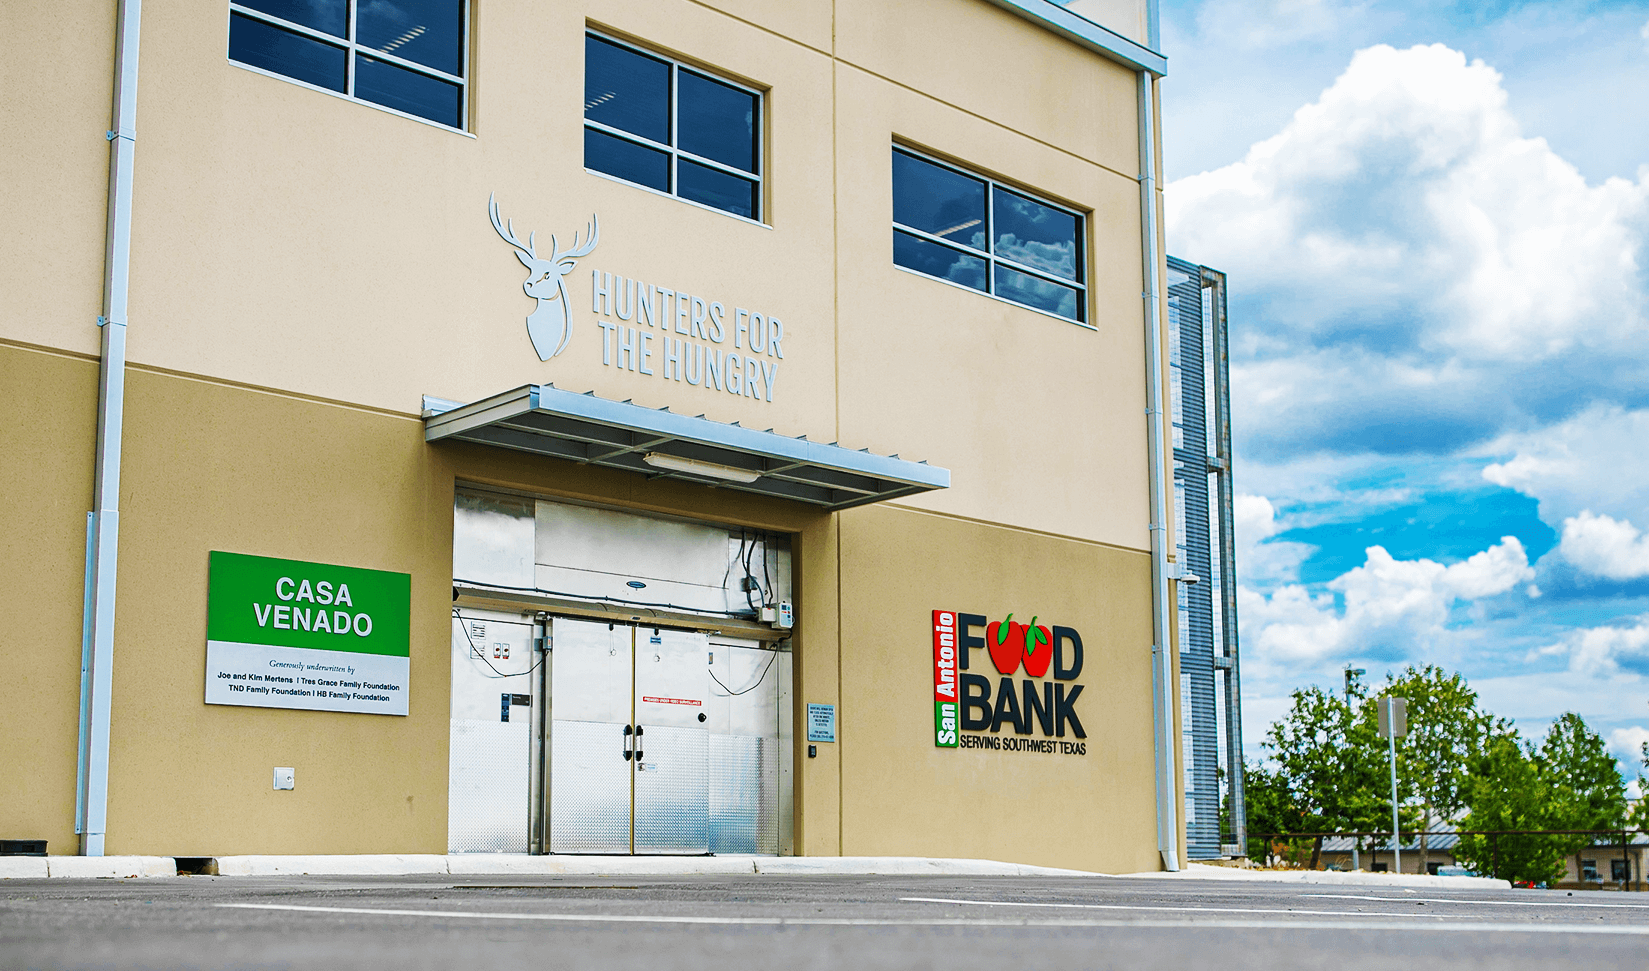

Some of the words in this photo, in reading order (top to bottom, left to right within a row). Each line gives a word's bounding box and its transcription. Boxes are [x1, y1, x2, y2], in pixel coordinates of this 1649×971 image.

[592, 269, 725, 343] HUNTERS
[735, 307, 784, 359] FOR
[598, 320, 654, 376] THE
[664, 336, 778, 402] HUNGRY
[275, 576, 353, 607] CASA
[253, 602, 373, 637] VENADO
[269, 660, 305, 671] Generously
[306, 663, 346, 673] underwritten
[347, 666, 356, 675] by
[936, 612, 955, 698] Antonio
[217, 672, 231, 680] Joe
[248, 674, 263, 682] Kim
[264, 675, 294, 684] Mertens
[318, 678, 338, 686] Grace
[340, 680, 362, 690] Family
[363, 682, 400, 691] Foundation
[228, 684, 244, 692] TND
[246, 686, 270, 695] Family
[272, 687, 311, 696] Foundation
[316, 690, 328, 698] HB
[328, 691, 351, 701] Family
[352, 692, 390, 702] Foundation
[959, 672, 1088, 739] BANK
[938, 703, 956, 745] San
[960, 734, 1001, 750] SERVING
[1002, 737, 1058, 754] SOUTHWEST
[1058, 741, 1087, 756] TEXAS
